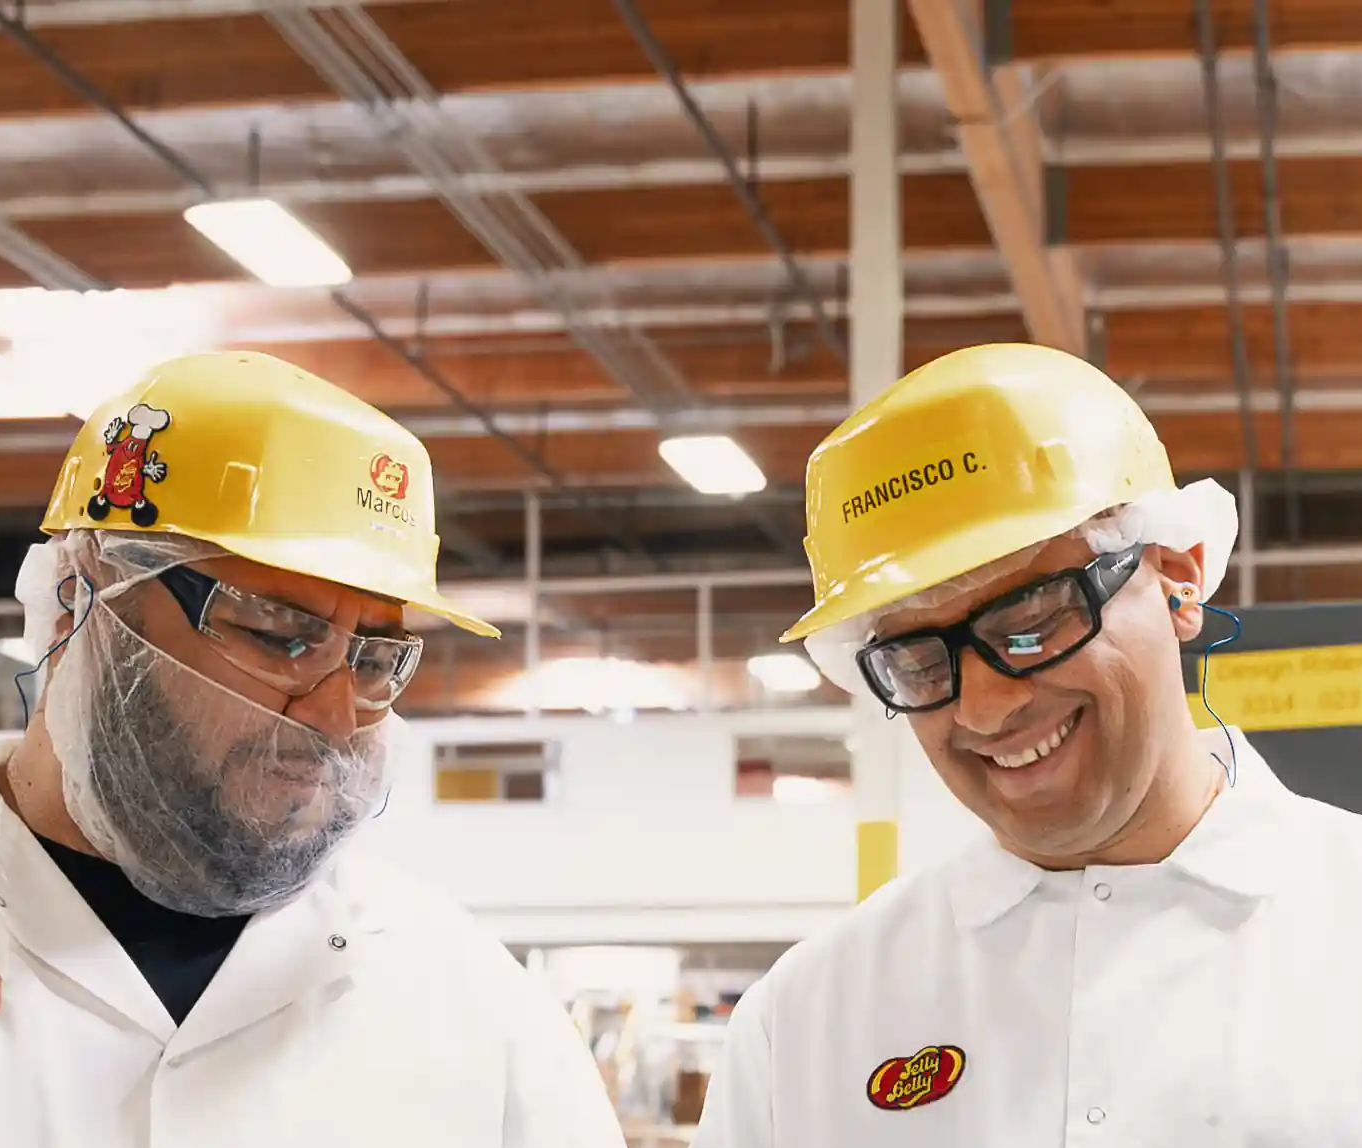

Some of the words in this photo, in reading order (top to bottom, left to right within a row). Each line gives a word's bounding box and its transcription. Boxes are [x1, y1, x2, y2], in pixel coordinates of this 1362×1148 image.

[841, 459, 955, 524] FRANCISCO
[962, 452, 988, 474] C.
[356, 487, 417, 527] Marcos
[899, 1052, 940, 1080] Jelly
[886, 1075, 932, 1104] Belly
